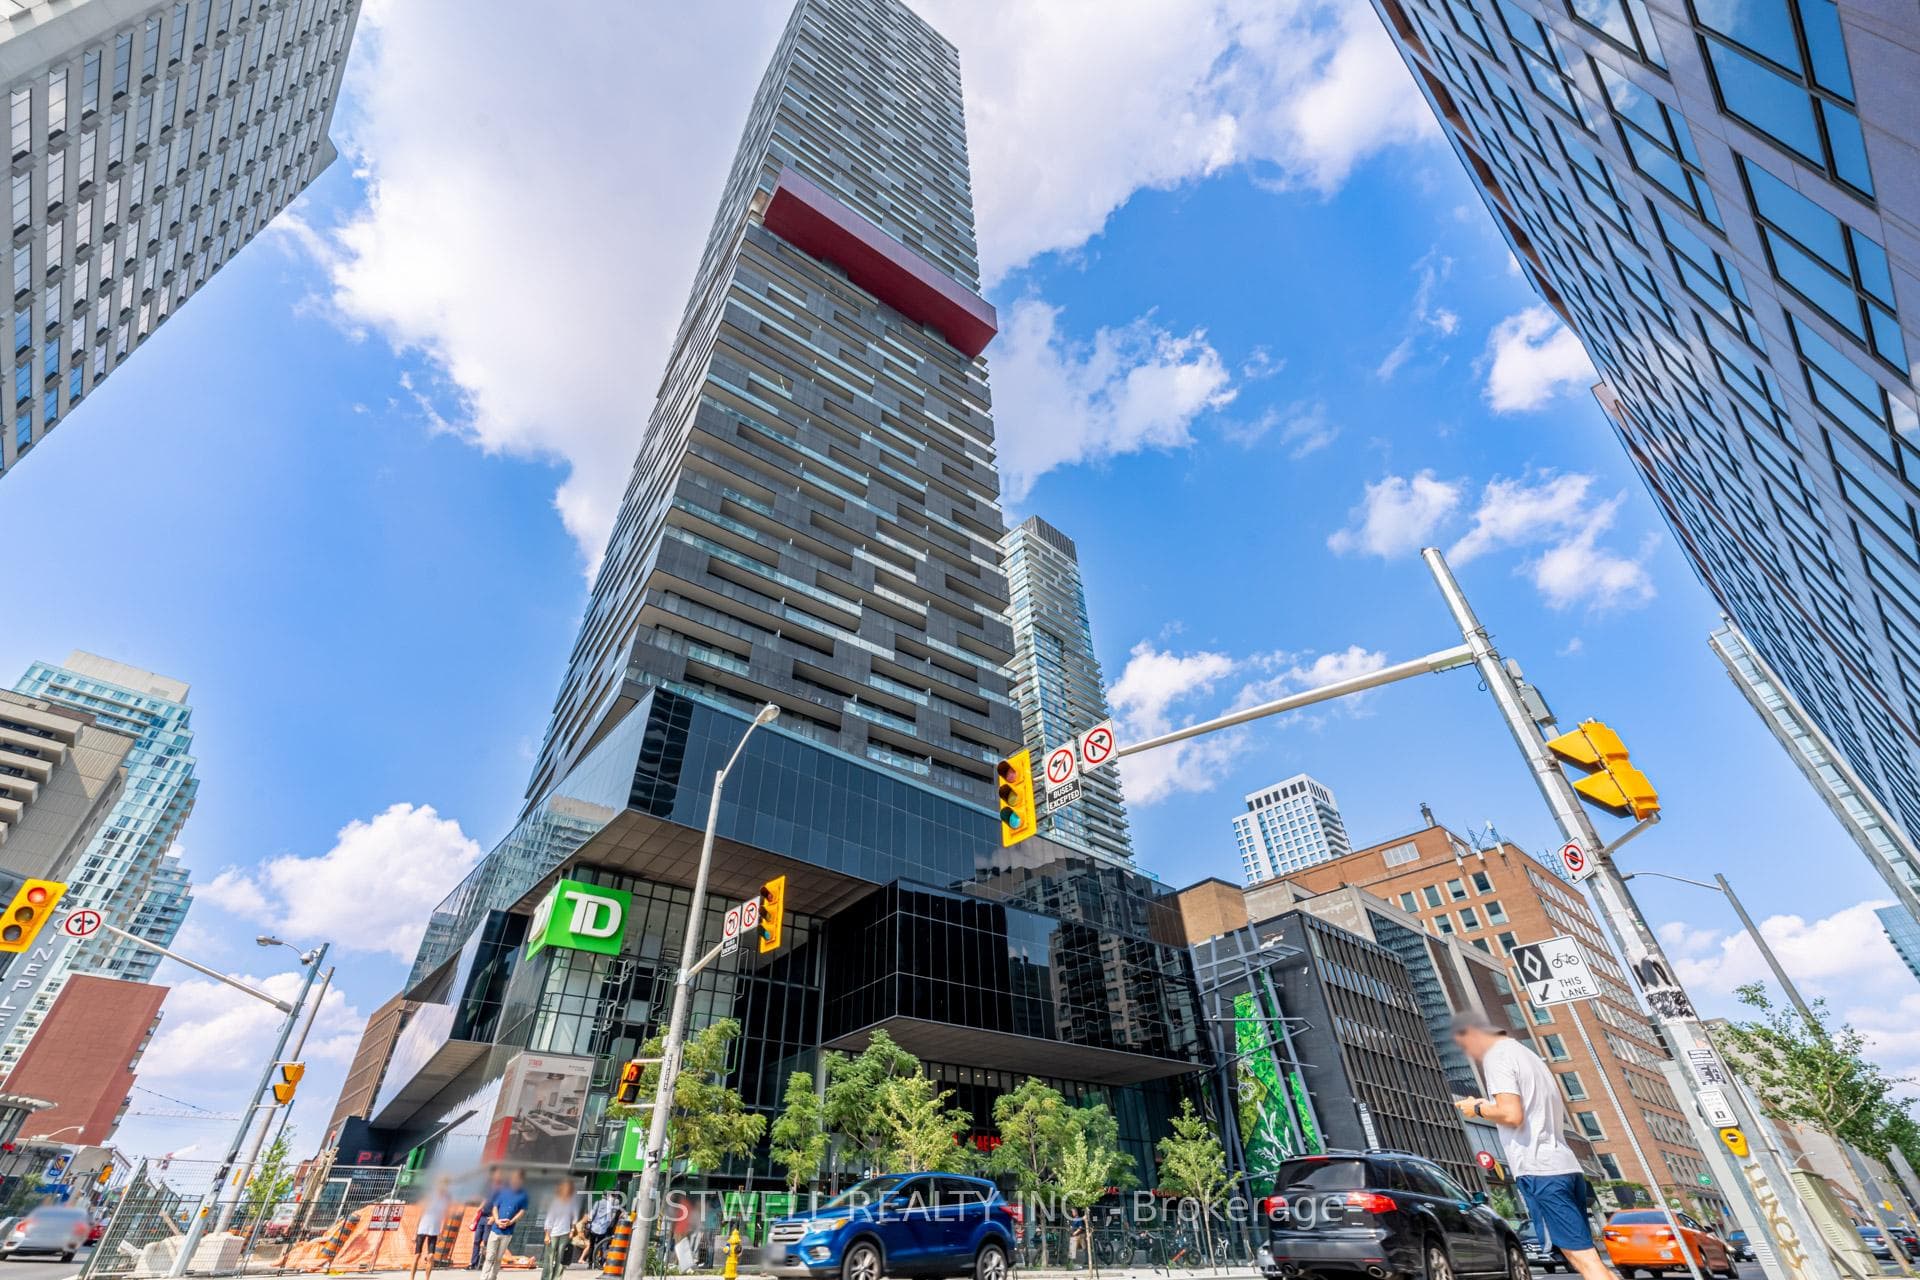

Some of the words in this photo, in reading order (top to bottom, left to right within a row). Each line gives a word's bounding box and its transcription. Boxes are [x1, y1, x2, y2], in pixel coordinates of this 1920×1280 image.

[1053, 783, 1073, 799] BUSES
[1049, 789, 1080, 810] EXCEPTED
[564, 890, 622, 938] TD
[1558, 976, 1582, 988] THIS
[1560, 986, 1590, 999] LANE
